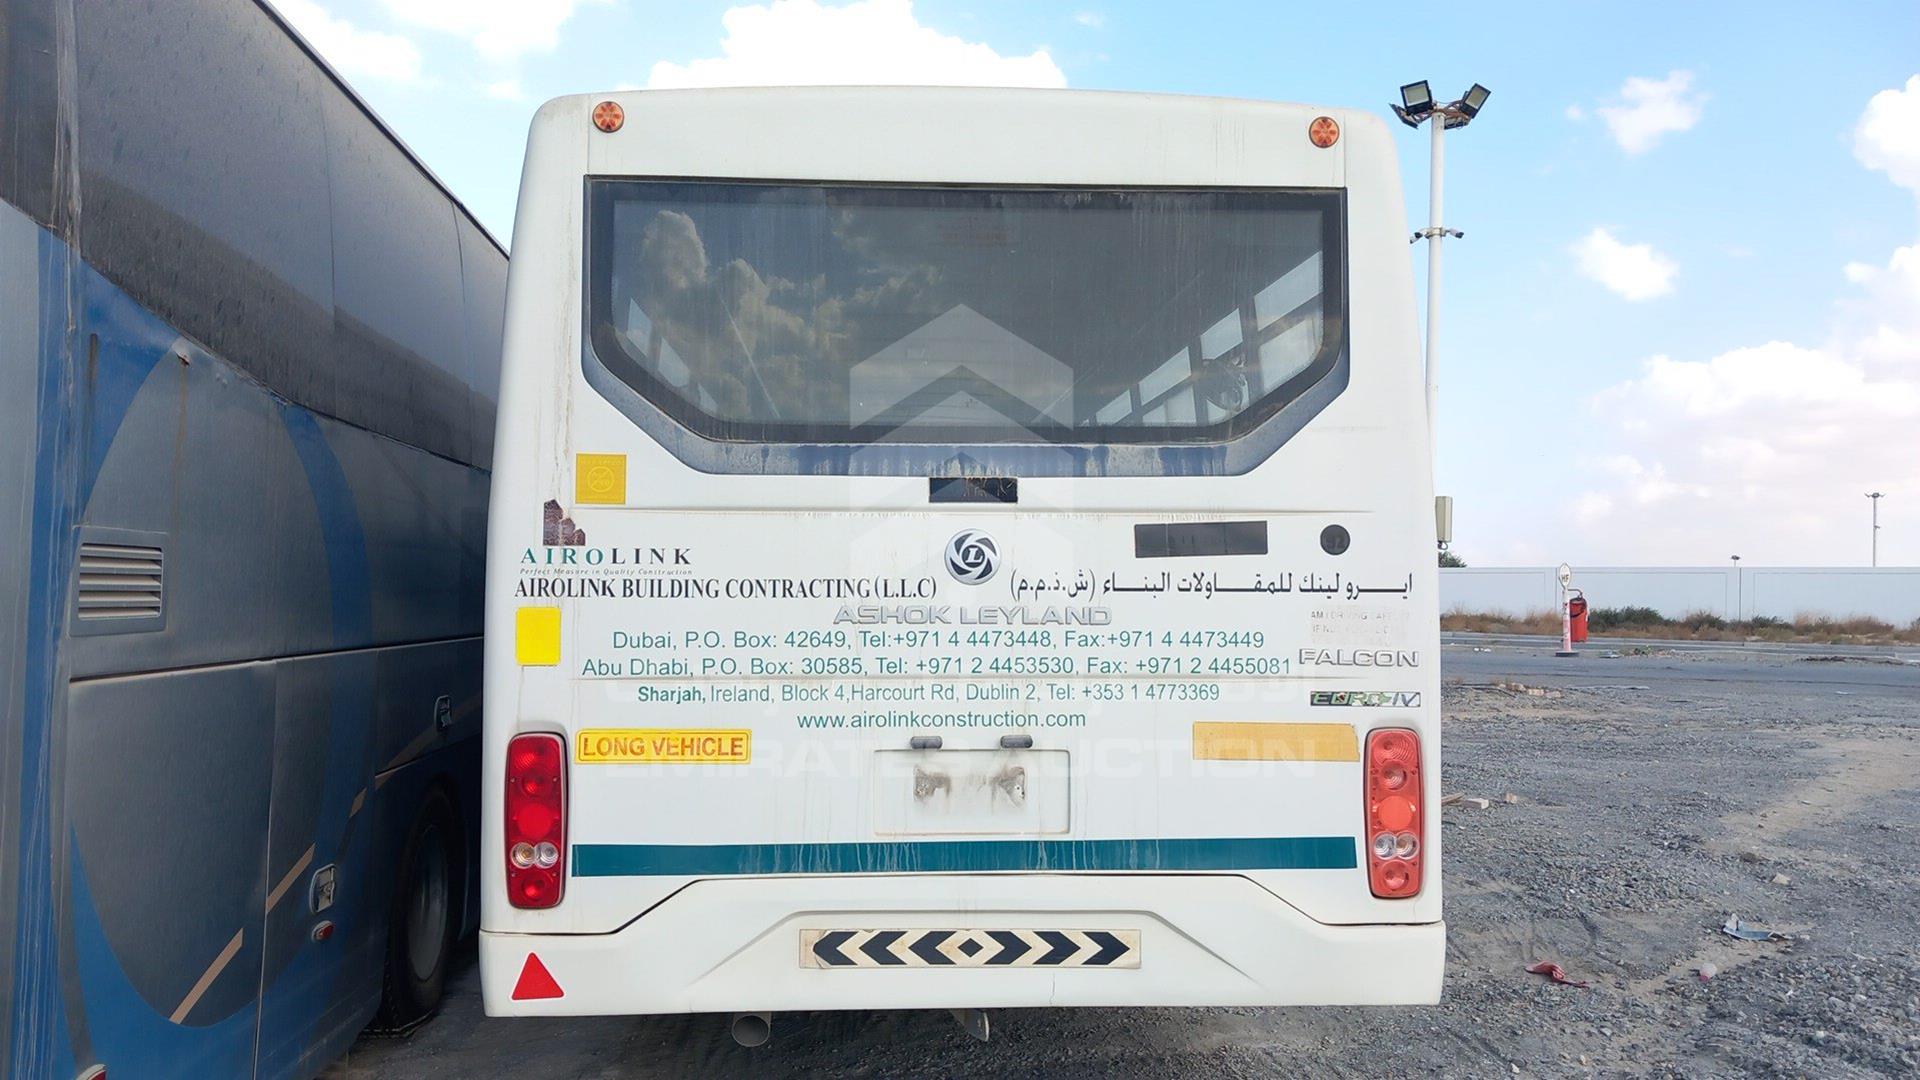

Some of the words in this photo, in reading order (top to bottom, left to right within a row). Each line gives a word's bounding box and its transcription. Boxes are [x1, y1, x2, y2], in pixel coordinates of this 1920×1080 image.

[520, 547, 692, 566] AIROLINK
[965, 547, 984, 563] L
[520, 567, 551, 577] Perfect
[553, 567, 589, 576] Measure
[592, 567, 601, 576] in
[603, 568, 636, 577] Quality
[637, 568, 693, 576] Construction
[514, 578, 616, 599] AIROLINK
[621, 578, 720, 599] BUILDING
[725, 578, 870, 599] CONTRACTING
[874, 577, 937, 599] (L.L.C)
[833, 606, 952, 625] ASHOK
[959, 606, 1113, 626] LEYLAND
[613, 631, 677, 651] Dubai,
[685, 630, 726, 649] P.O.
[733, 630, 777, 649] Box:
[783, 630, 852, 651] 42649,
[858, 630, 939, 649] Tel:+971
[947, 630, 961, 648] 4
[966, 630, 1057, 650] 4473448,
[1064, 630, 1153, 648] Fax:+971
[1161, 630, 1174, 648] 4
[1179, 630, 1265, 649] 4473449
[581, 659, 622, 676] Abu
[629, 658, 694, 678] Dhabi,
[702, 658, 743, 676] P.O.
[750, 658, 794, 676] Box:
[801, 657, 868, 678] 30585,
[875, 657, 908, 675] Tel:
[915, 657, 962, 675] +971
[970, 657, 983, 675] 2
[988, 657, 1079, 677] 4453530,
[1087, 657, 1128, 675] Fax:
[1135, 657, 1181, 675] +971
[1189, 657, 1202, 675] 2
[1207, 656, 1290, 675] 4455081
[1298, 648, 1419, 668] FALCON
[637, 685, 707, 705] Sharjah,
[710, 685, 775, 704] Ireland,
[781, 684, 829, 702] Block
[931, 684, 960, 703] Rd,
[966, 684, 1020, 701] Dublin
[1025, 684, 1041, 703] 2,
[1045, 683, 1076, 701] Tel:
[1081, 684, 1124, 701] +353
[1130, 684, 1138, 700] 1
[1145, 683, 1220, 701] 4773369
[797, 709, 1086, 729] www.airolinkconstruction.com
[583, 736, 645, 756] LONG
[652, 736, 744, 756] VEHICLE
